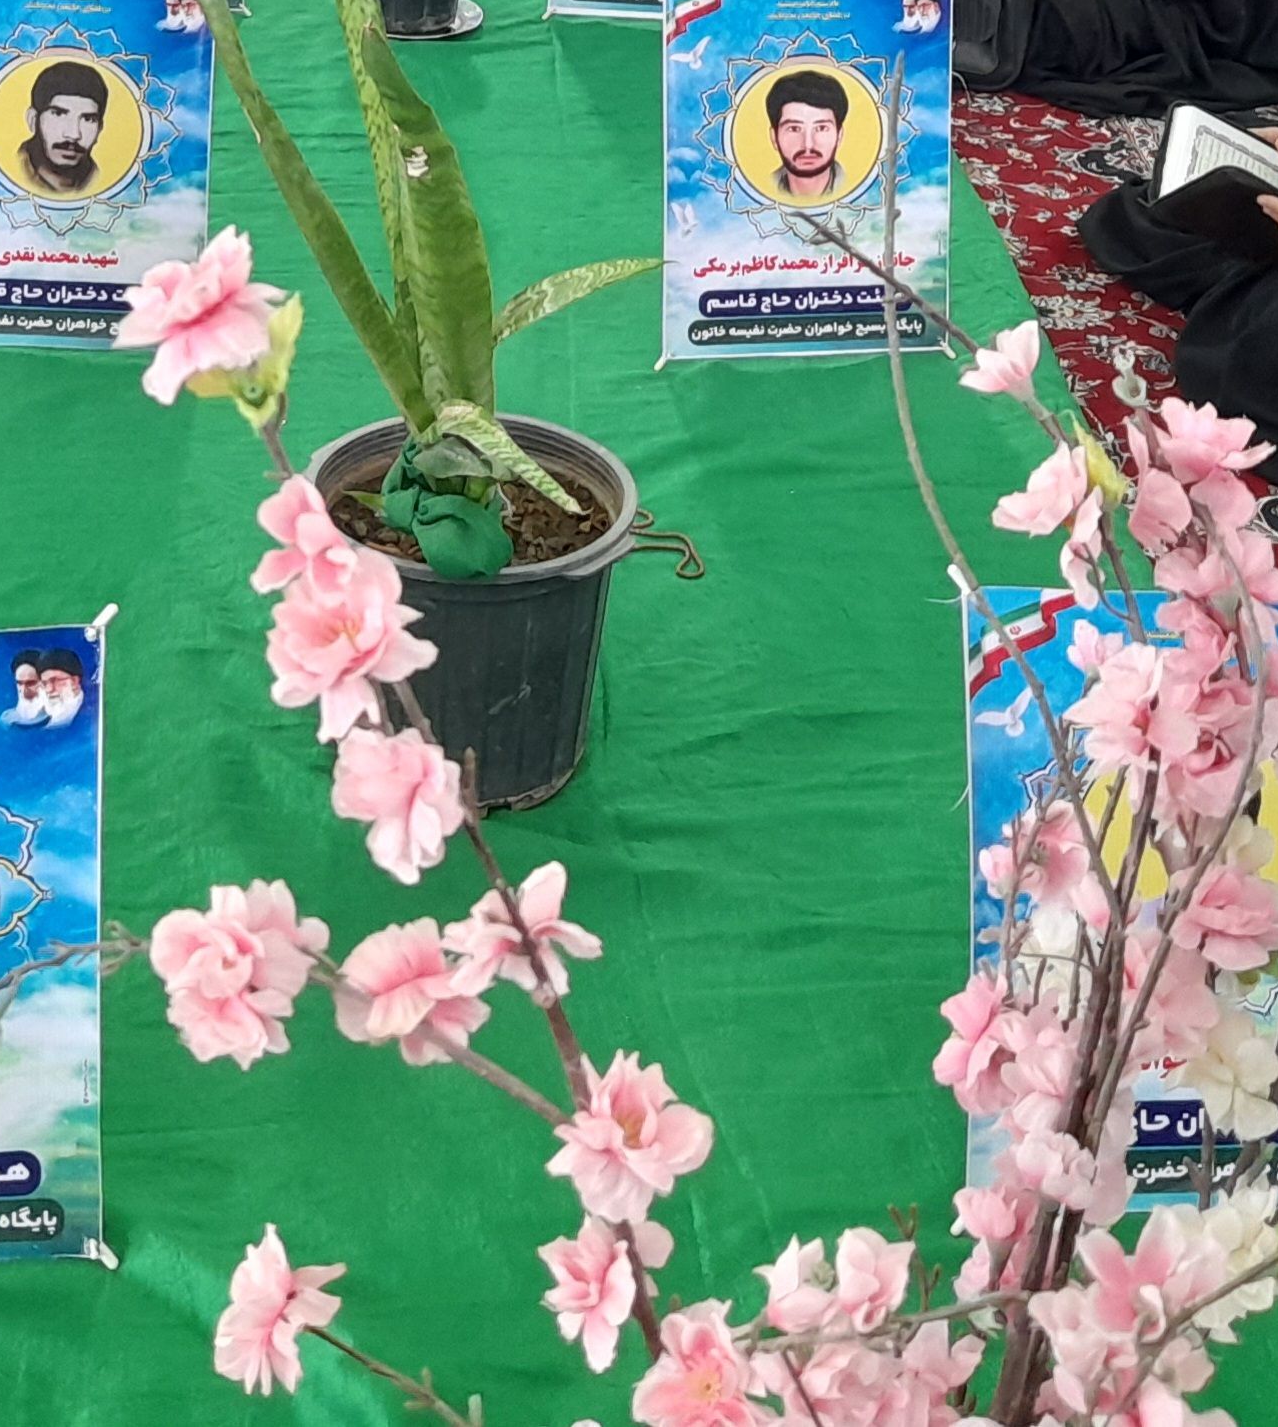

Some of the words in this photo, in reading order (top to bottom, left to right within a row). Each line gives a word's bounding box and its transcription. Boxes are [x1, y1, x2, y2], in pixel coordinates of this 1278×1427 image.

[37, 249, 81, 265] محمد
[82, 249, 120, 269] شهید
[875, 250, 916, 272] جاناز
[10, 283, 44, 305] حاج
[46, 284, 109, 305] دختران
[706, 293, 758, 313] قاسم
[759, 293, 792, 313] حاج
[794, 292, 853, 310] دختران
[16, 315, 55, 331] حضرت
[55, 317, 108, 334] خواهران
[728, 324, 766, 338] نفیسه
[767, 324, 803, 338] حضرت
[804, 321, 854, 337] خواهران
[855, 322, 887, 337] بسیج
[895, 318, 923, 336] پایگا
[690, 325, 726, 341] خاتون
[1129, 1107, 1172, 1132] حا
[1132, 1159, 1189, 1184] حضرت
